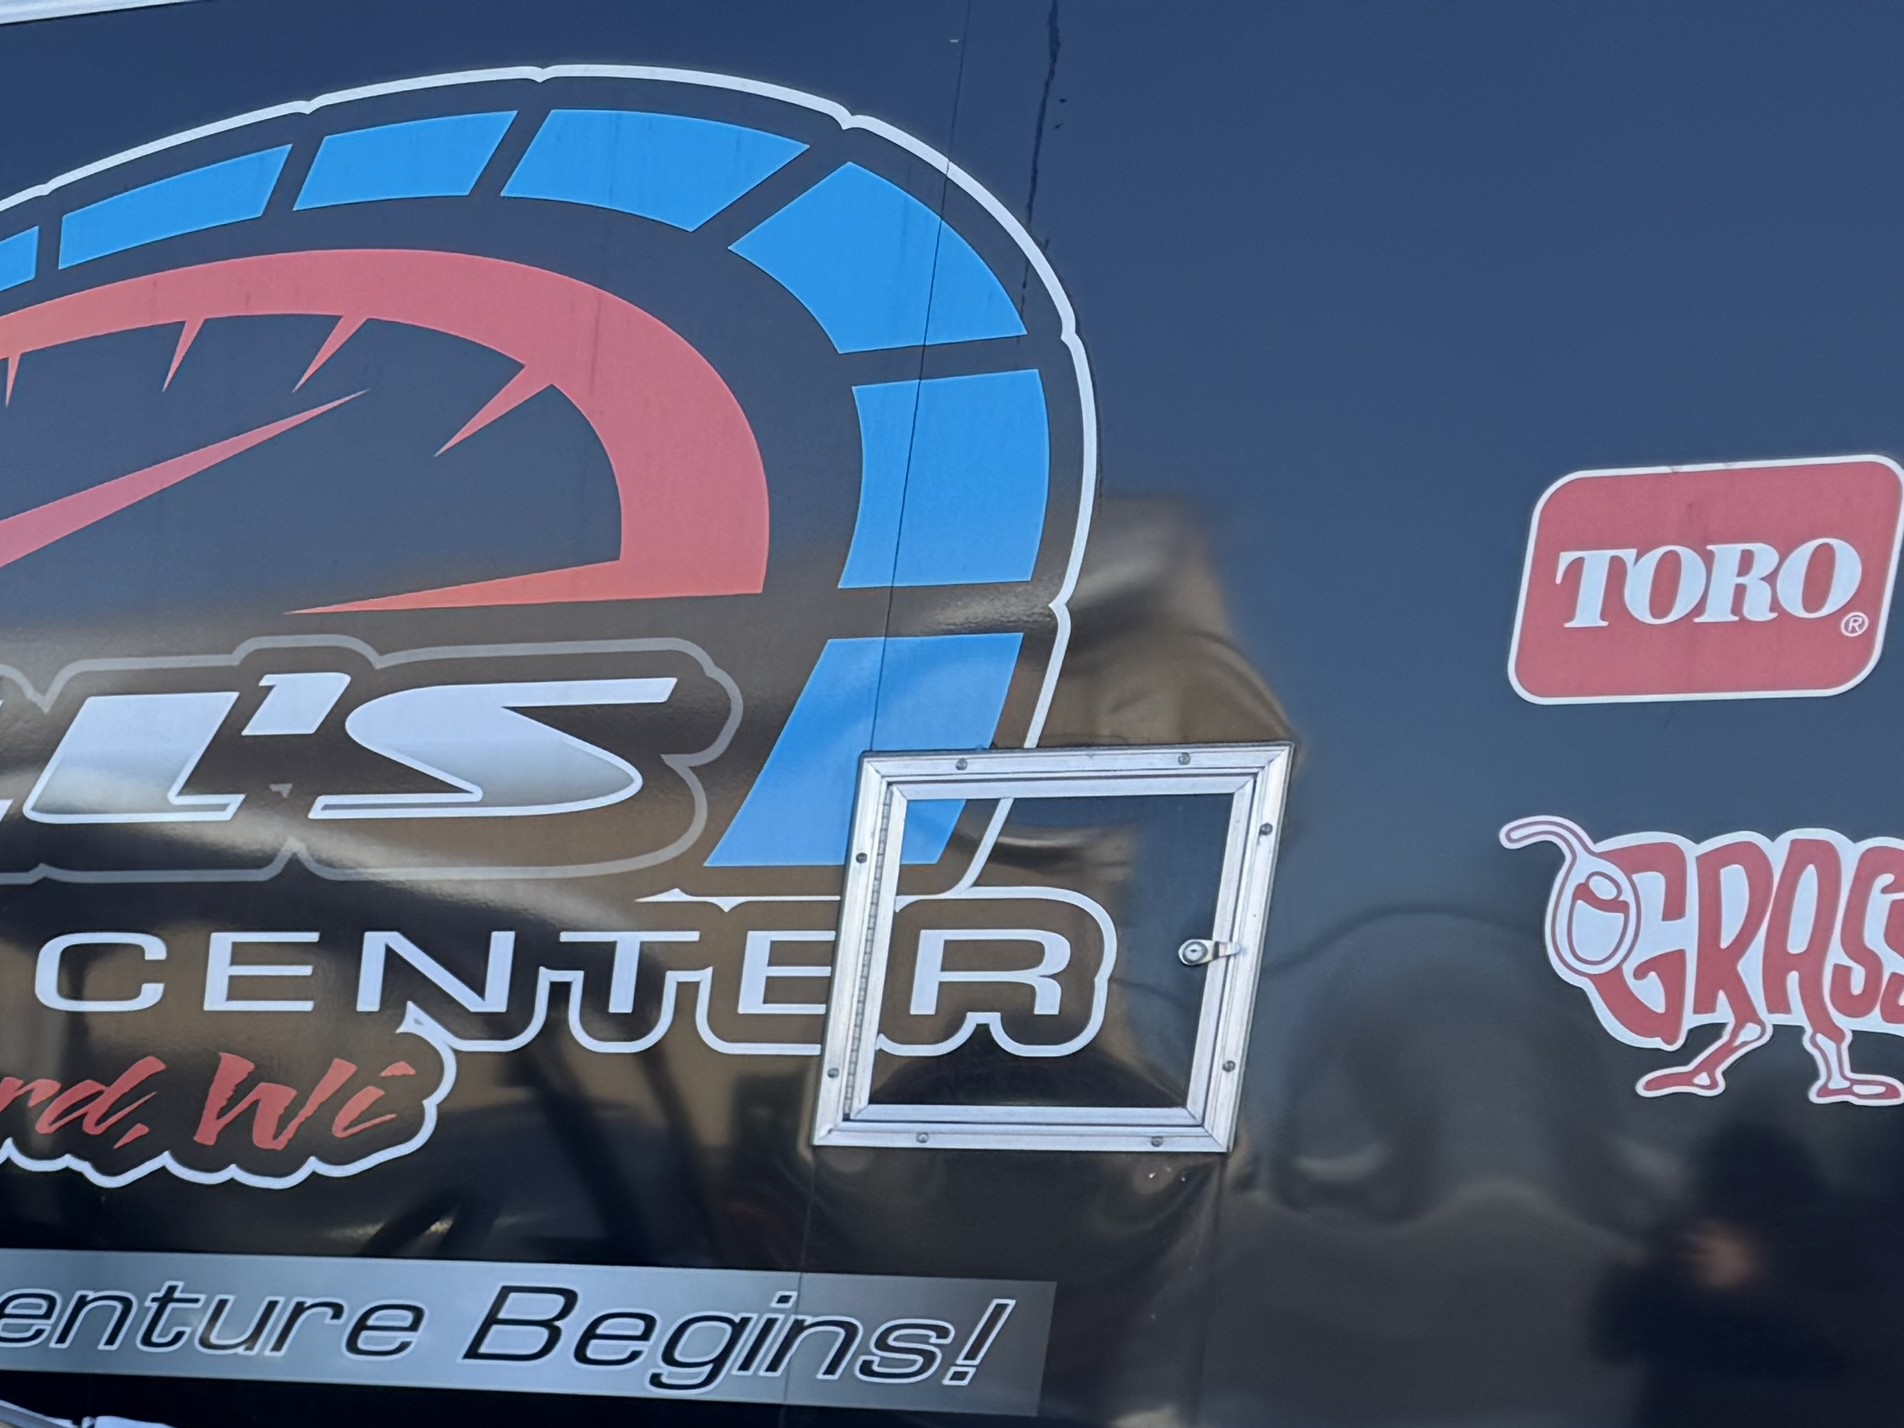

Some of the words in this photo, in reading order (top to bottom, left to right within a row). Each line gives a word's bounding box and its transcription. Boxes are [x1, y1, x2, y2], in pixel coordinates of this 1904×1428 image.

[1555, 538, 1863, 629] TORO
[33, 927, 1075, 1017] CENTER
[192, 1052, 416, 1151] Wi
[461, 1284, 1017, 1393] Begins!
